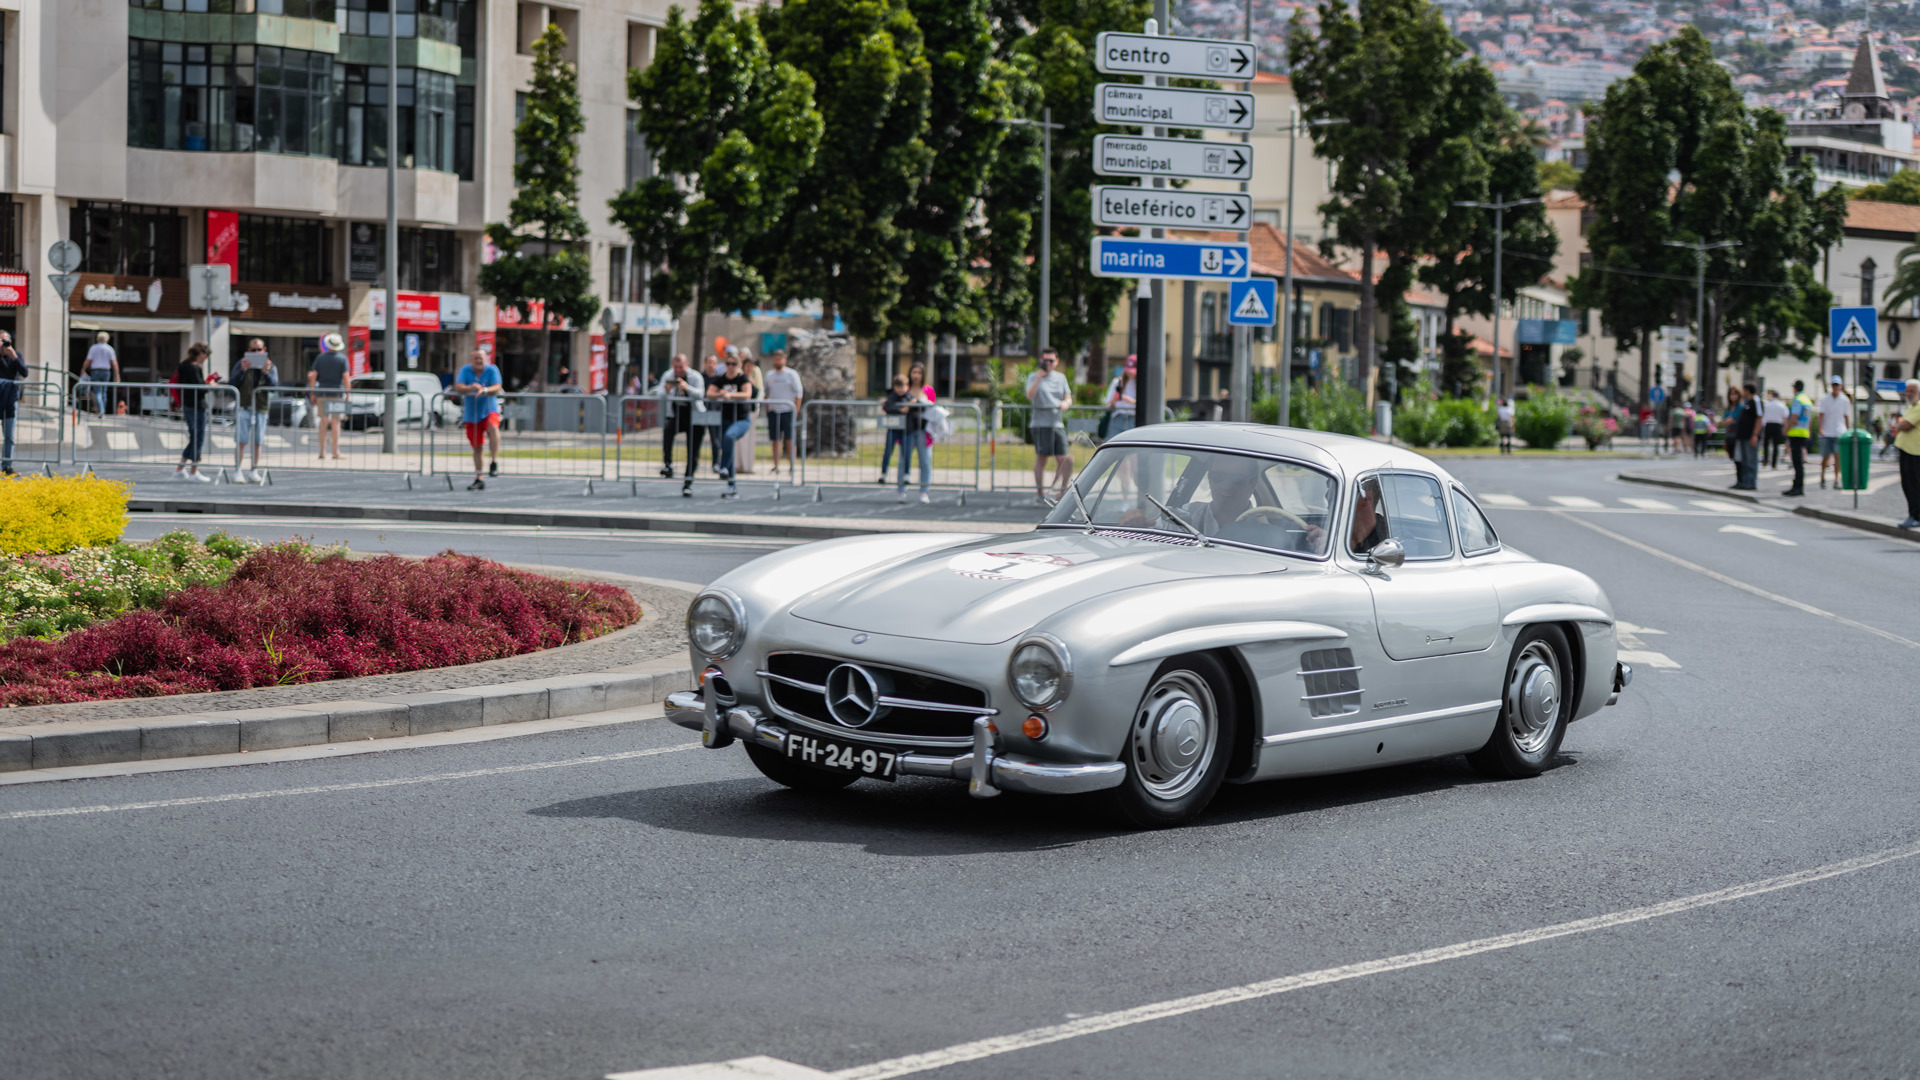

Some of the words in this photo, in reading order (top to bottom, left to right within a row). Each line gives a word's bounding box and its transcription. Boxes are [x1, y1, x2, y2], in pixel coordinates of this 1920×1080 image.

[1108, 47, 1170, 65] centro
[1107, 88, 1143, 101] câmara
[1106, 105, 1173, 120] municipal
[1106, 141, 1148, 152] mercado
[1105, 156, 1172, 171] municipal
[1105, 197, 1196, 218] teleférico
[1102, 250, 1166, 268] marina
[787, 734, 895, 776] FH-24-97
